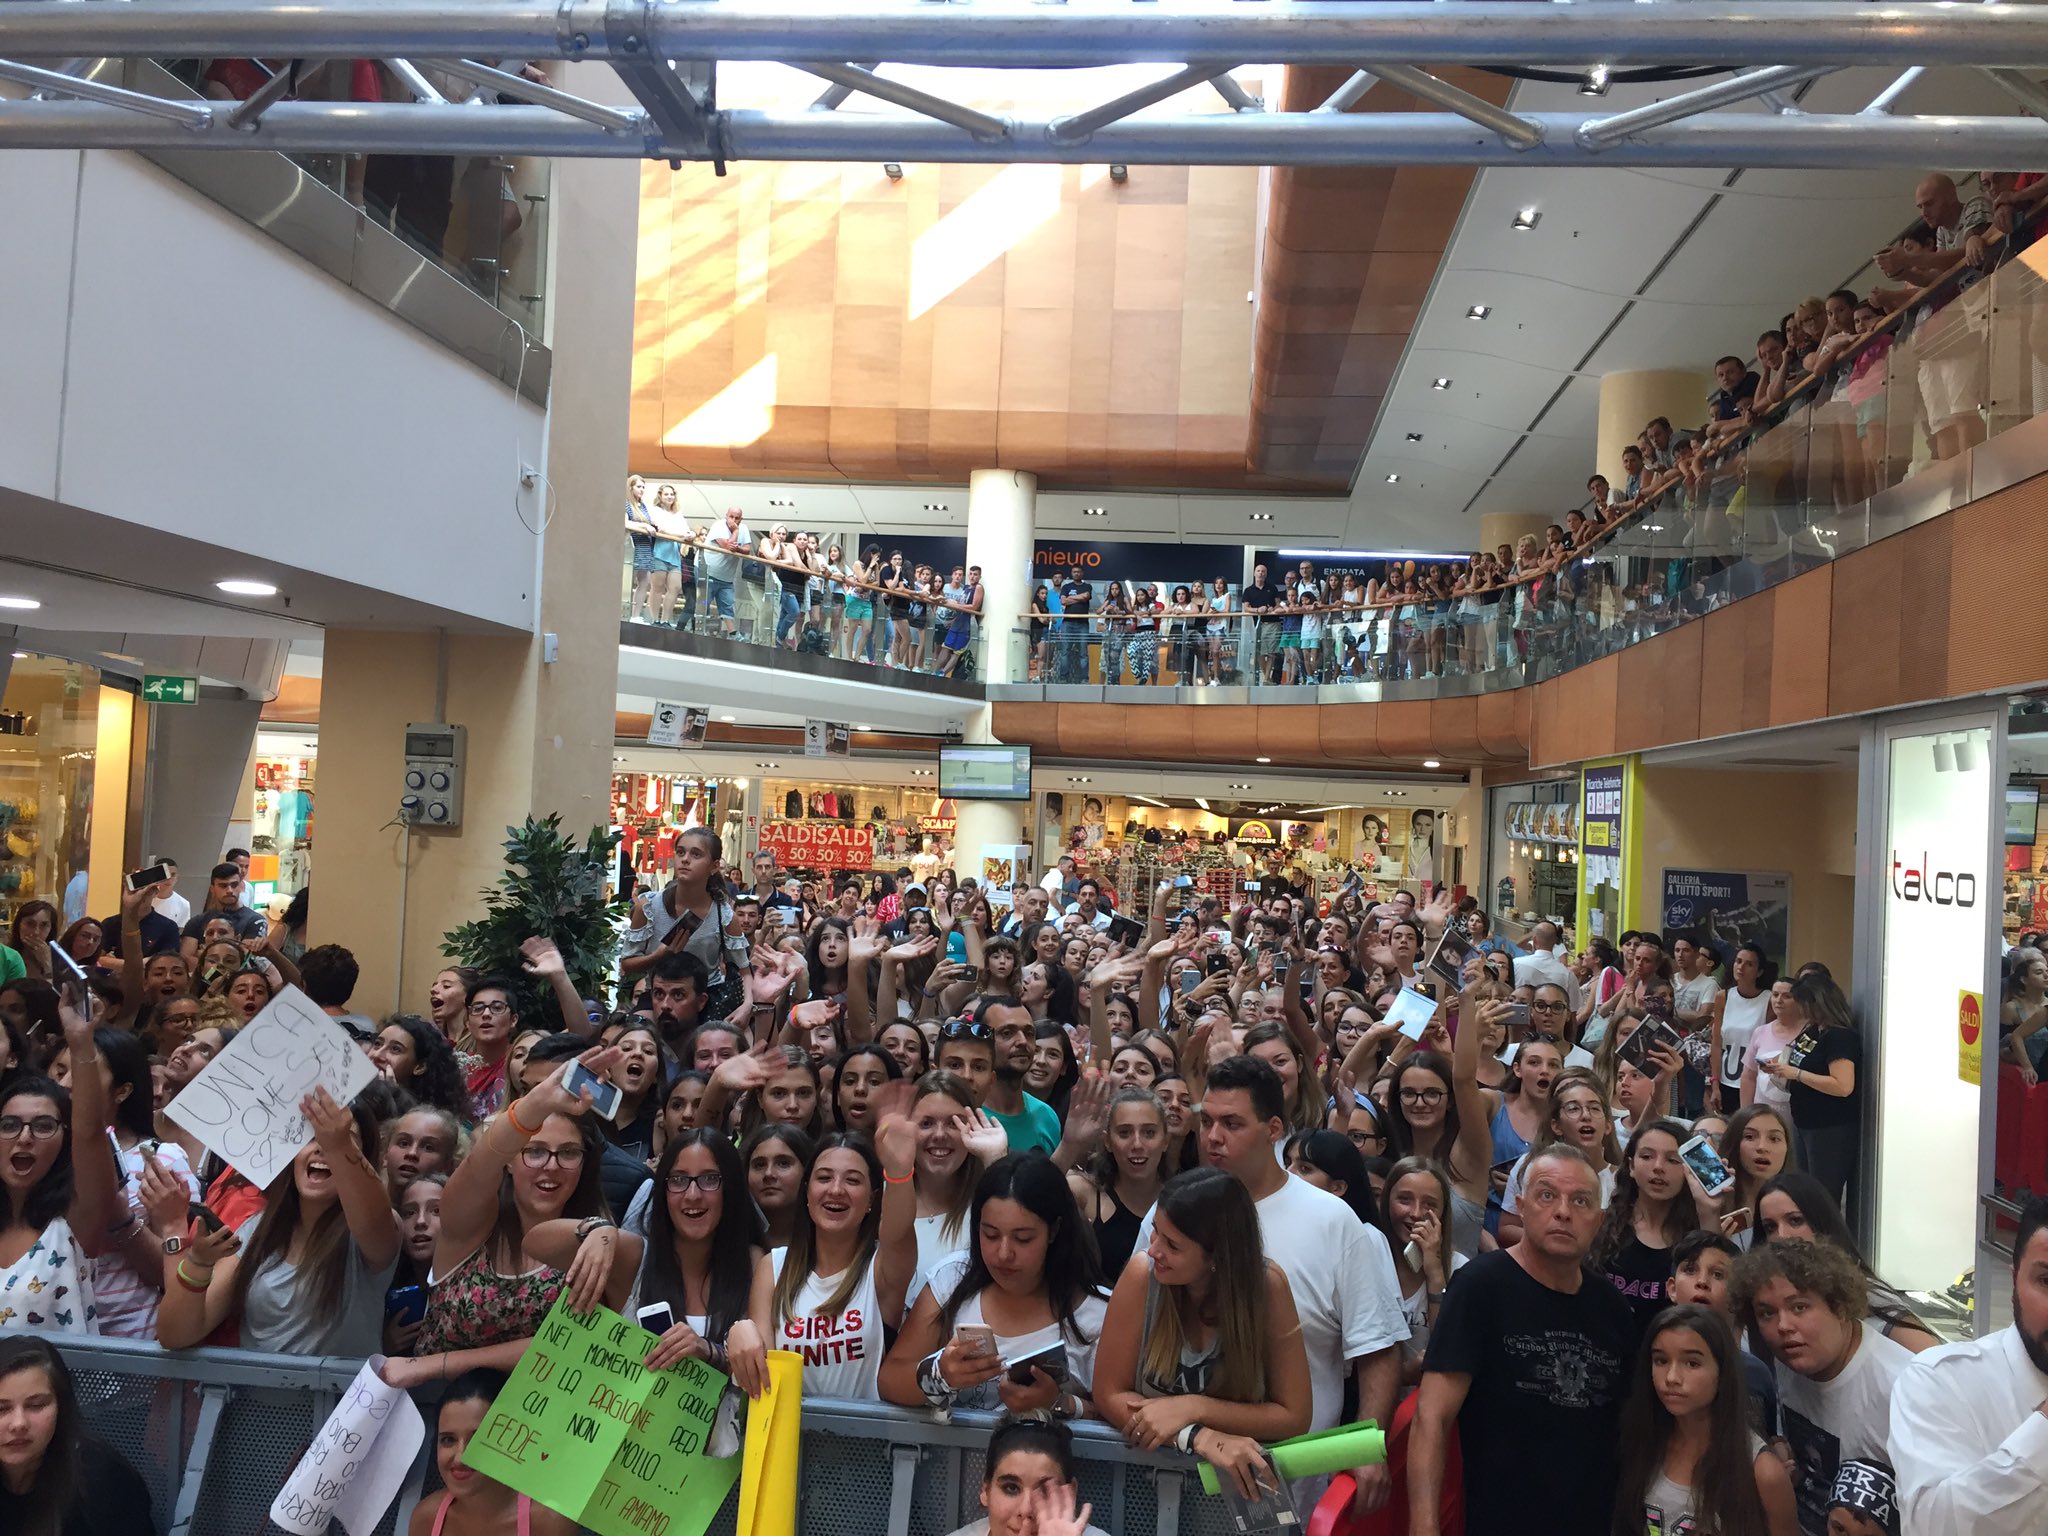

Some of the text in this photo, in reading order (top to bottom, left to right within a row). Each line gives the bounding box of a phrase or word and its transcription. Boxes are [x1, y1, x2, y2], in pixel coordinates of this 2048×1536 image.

[1035, 546, 1102, 567] nieuro
[1323, 567, 1366, 576] ENTRATA
[759, 825, 875, 847] SALDI SALDI
[922, 818, 956, 831] SCARP
[788, 847, 815, 862] 50%
[815, 849, 842, 863] 50%
[845, 850, 873, 864] 50%
[1667, 885, 1731, 898] A TUTTO SPORT!
[1892, 849, 1976, 908] talco
[1671, 905, 1691, 917] sky
[177, 1001, 315, 1126] UNICA
[223, 1075, 298, 1158] COME
[606, 1321, 631, 1348] CHE
[639, 1334, 659, 1357] TU
[783, 1309, 864, 1339] GIRLS
[543, 1320, 572, 1351] NEI
[583, 1342, 645, 1384] MOMENTI
[651, 1376, 670, 1397] DI
[677, 1391, 718, 1424] CROLLO
[522, 1390, 550, 1418] CUI
[565, 1412, 601, 1444] NON
[528, 1351, 700, 1457] TU LA RAGIONE PER
[486, 1413, 671, 1536] FEDE TI AMIAMO
